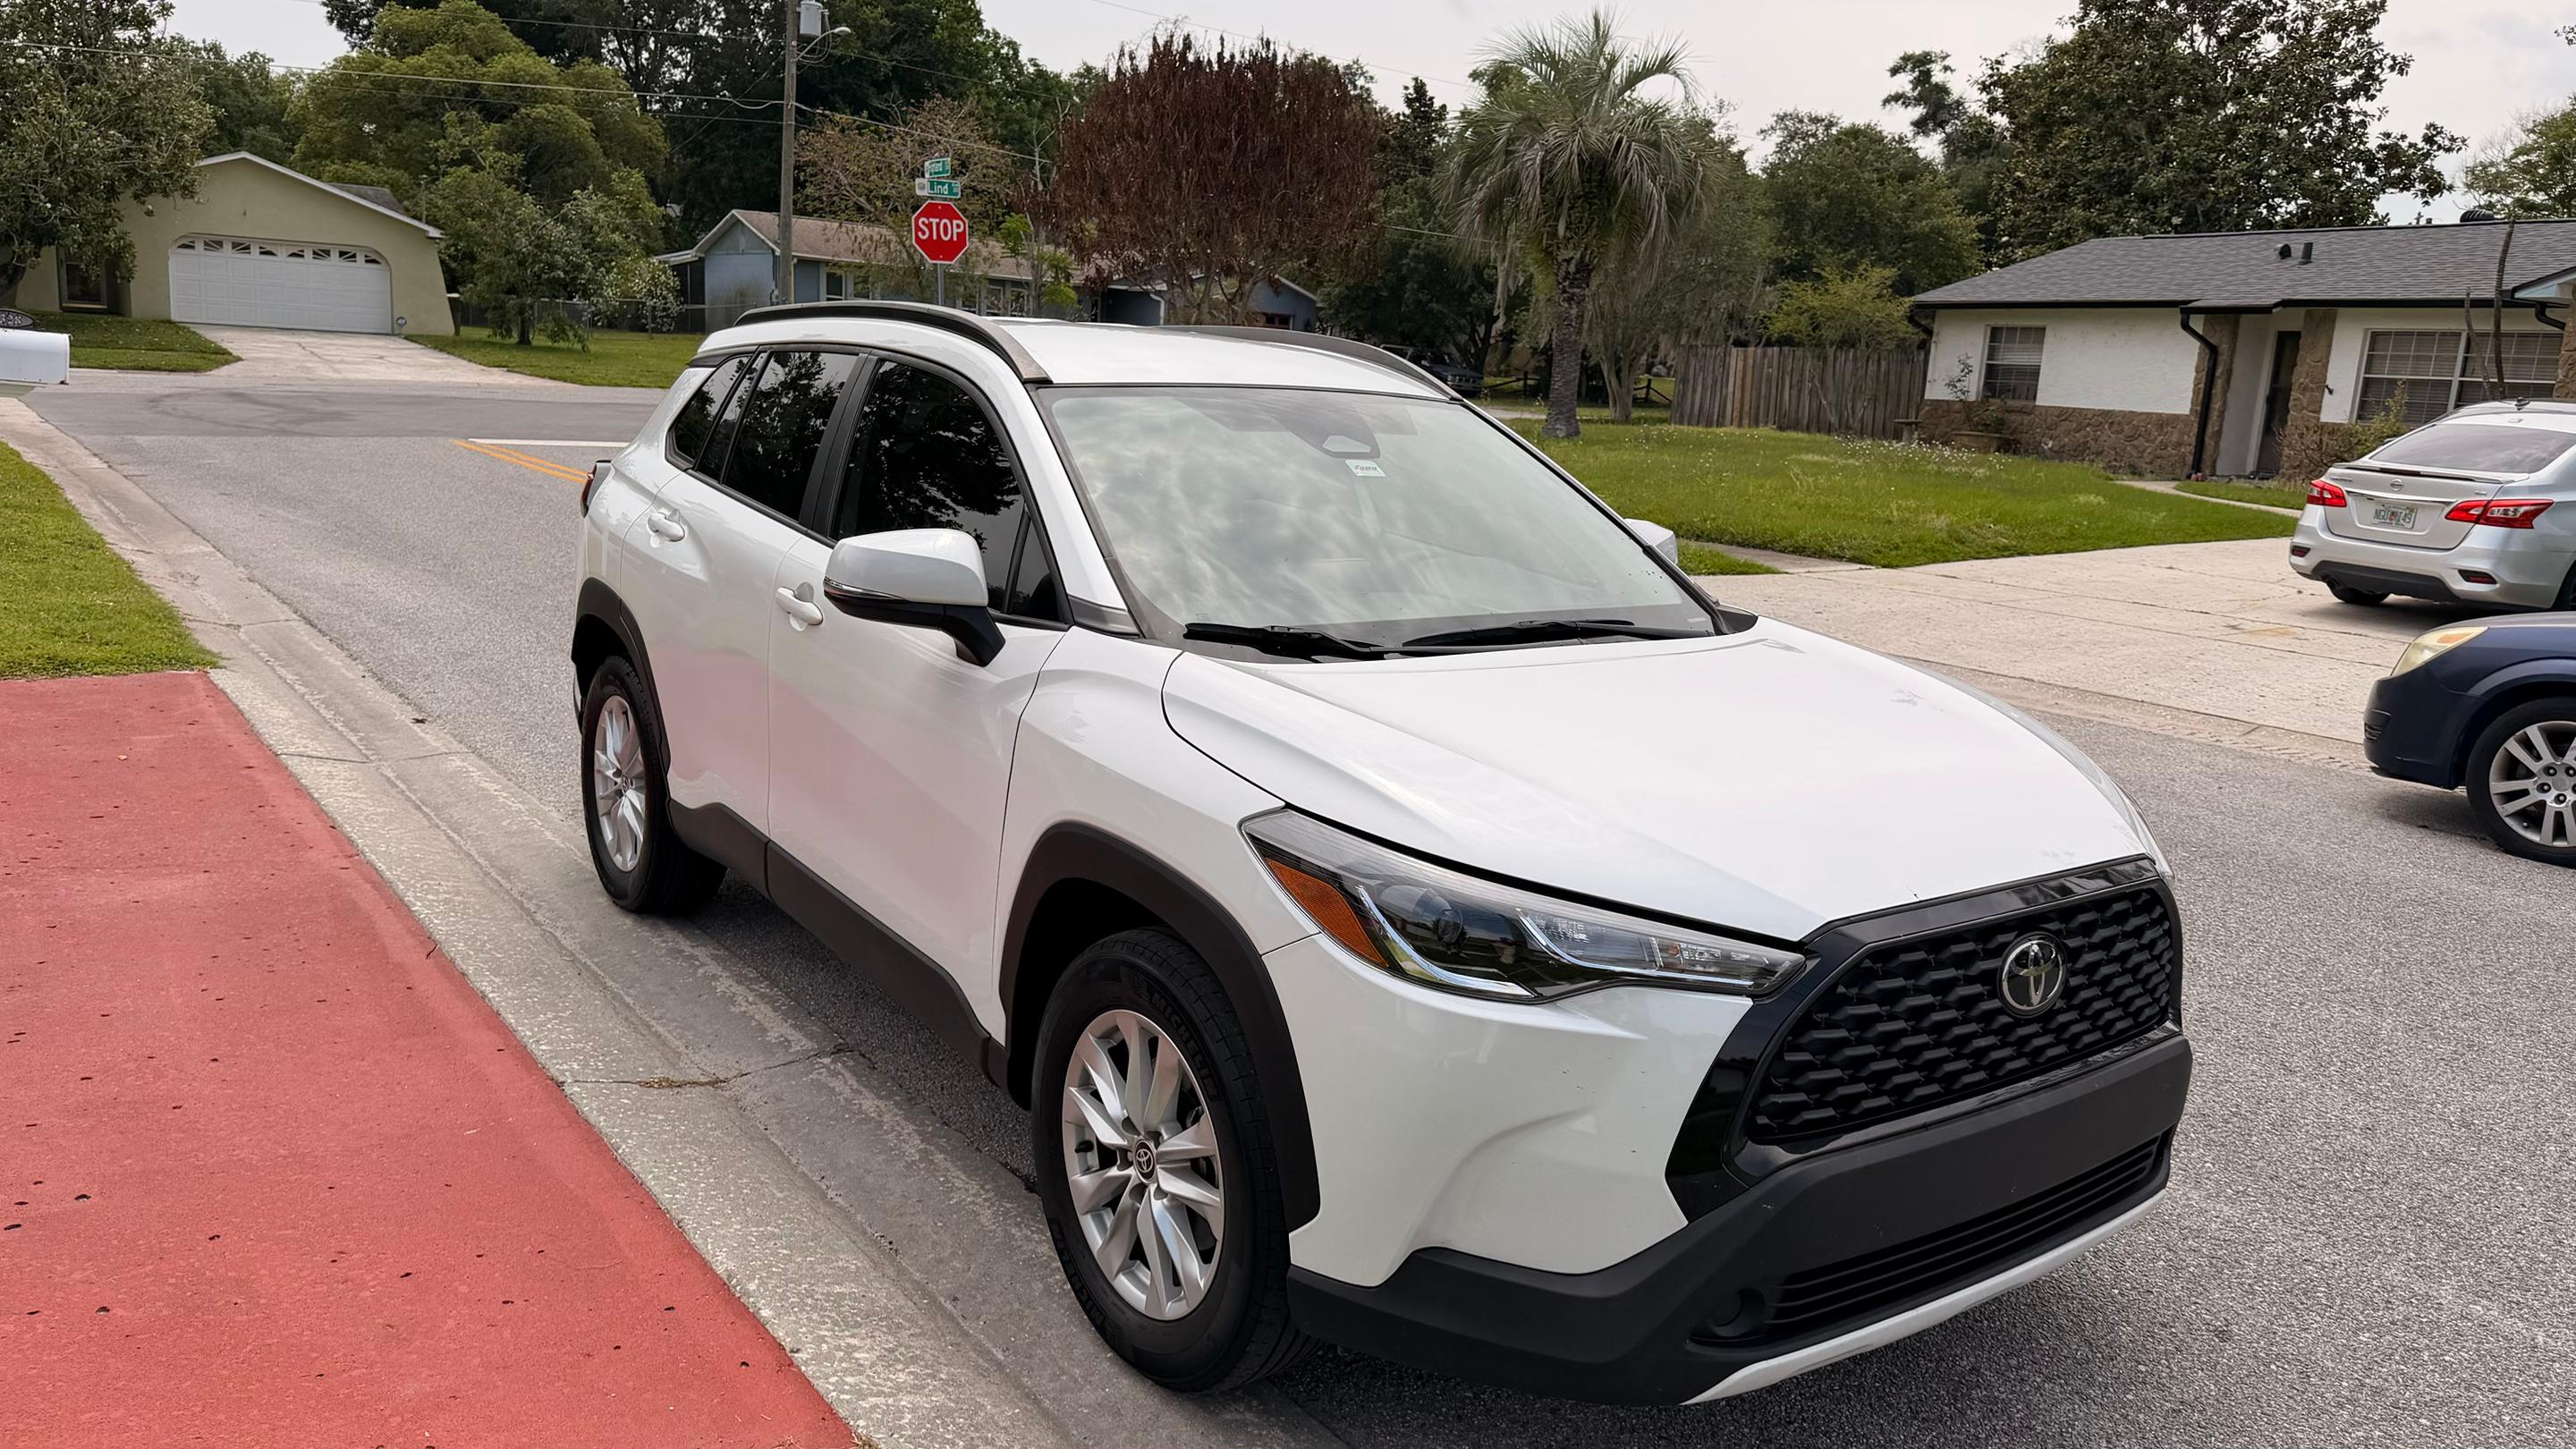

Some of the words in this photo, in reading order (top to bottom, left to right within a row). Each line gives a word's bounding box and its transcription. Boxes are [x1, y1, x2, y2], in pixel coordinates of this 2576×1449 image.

[928, 181, 948, 194] Lind
[918, 217, 964, 242] STOP
[1150, 992, 1218, 1102] MICHELIN
